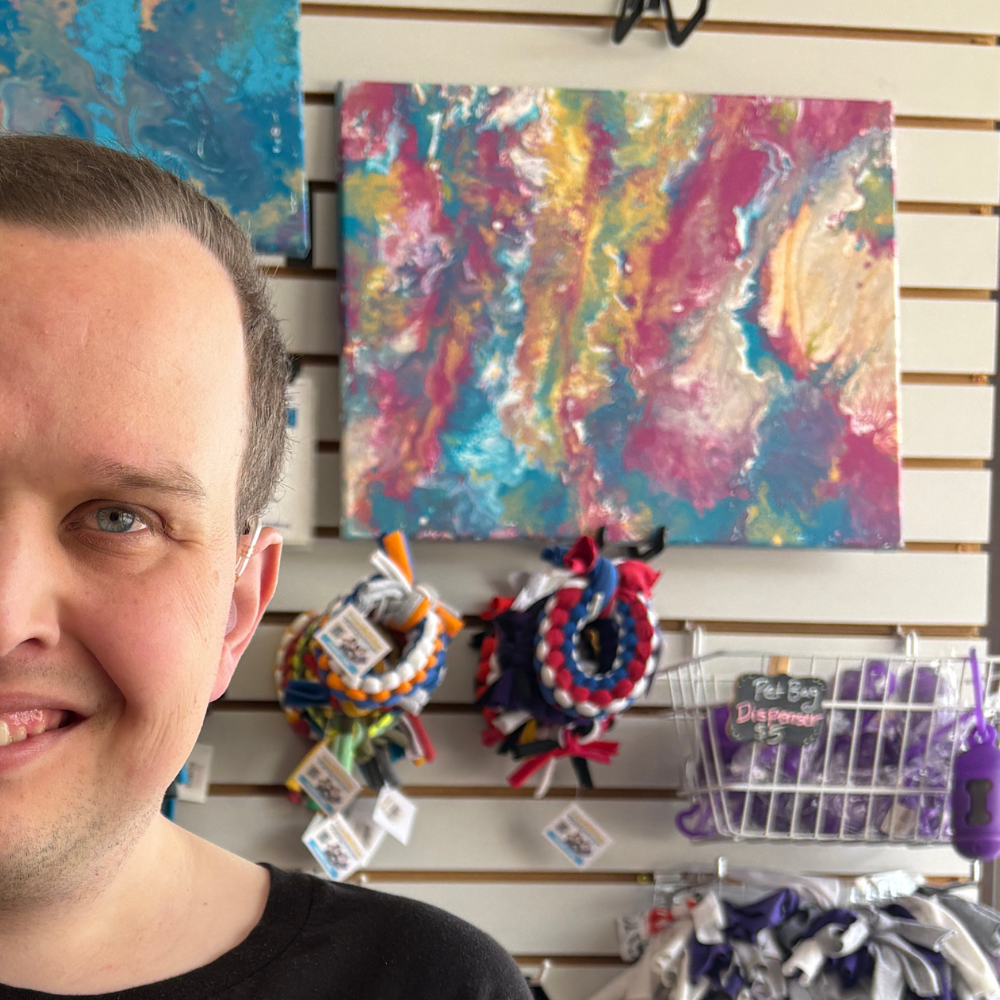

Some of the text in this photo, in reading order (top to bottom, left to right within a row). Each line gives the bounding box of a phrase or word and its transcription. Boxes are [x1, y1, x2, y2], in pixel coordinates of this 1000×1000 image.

[752, 678, 818, 713] Pet Bag
[753, 722, 786, 745] $5
